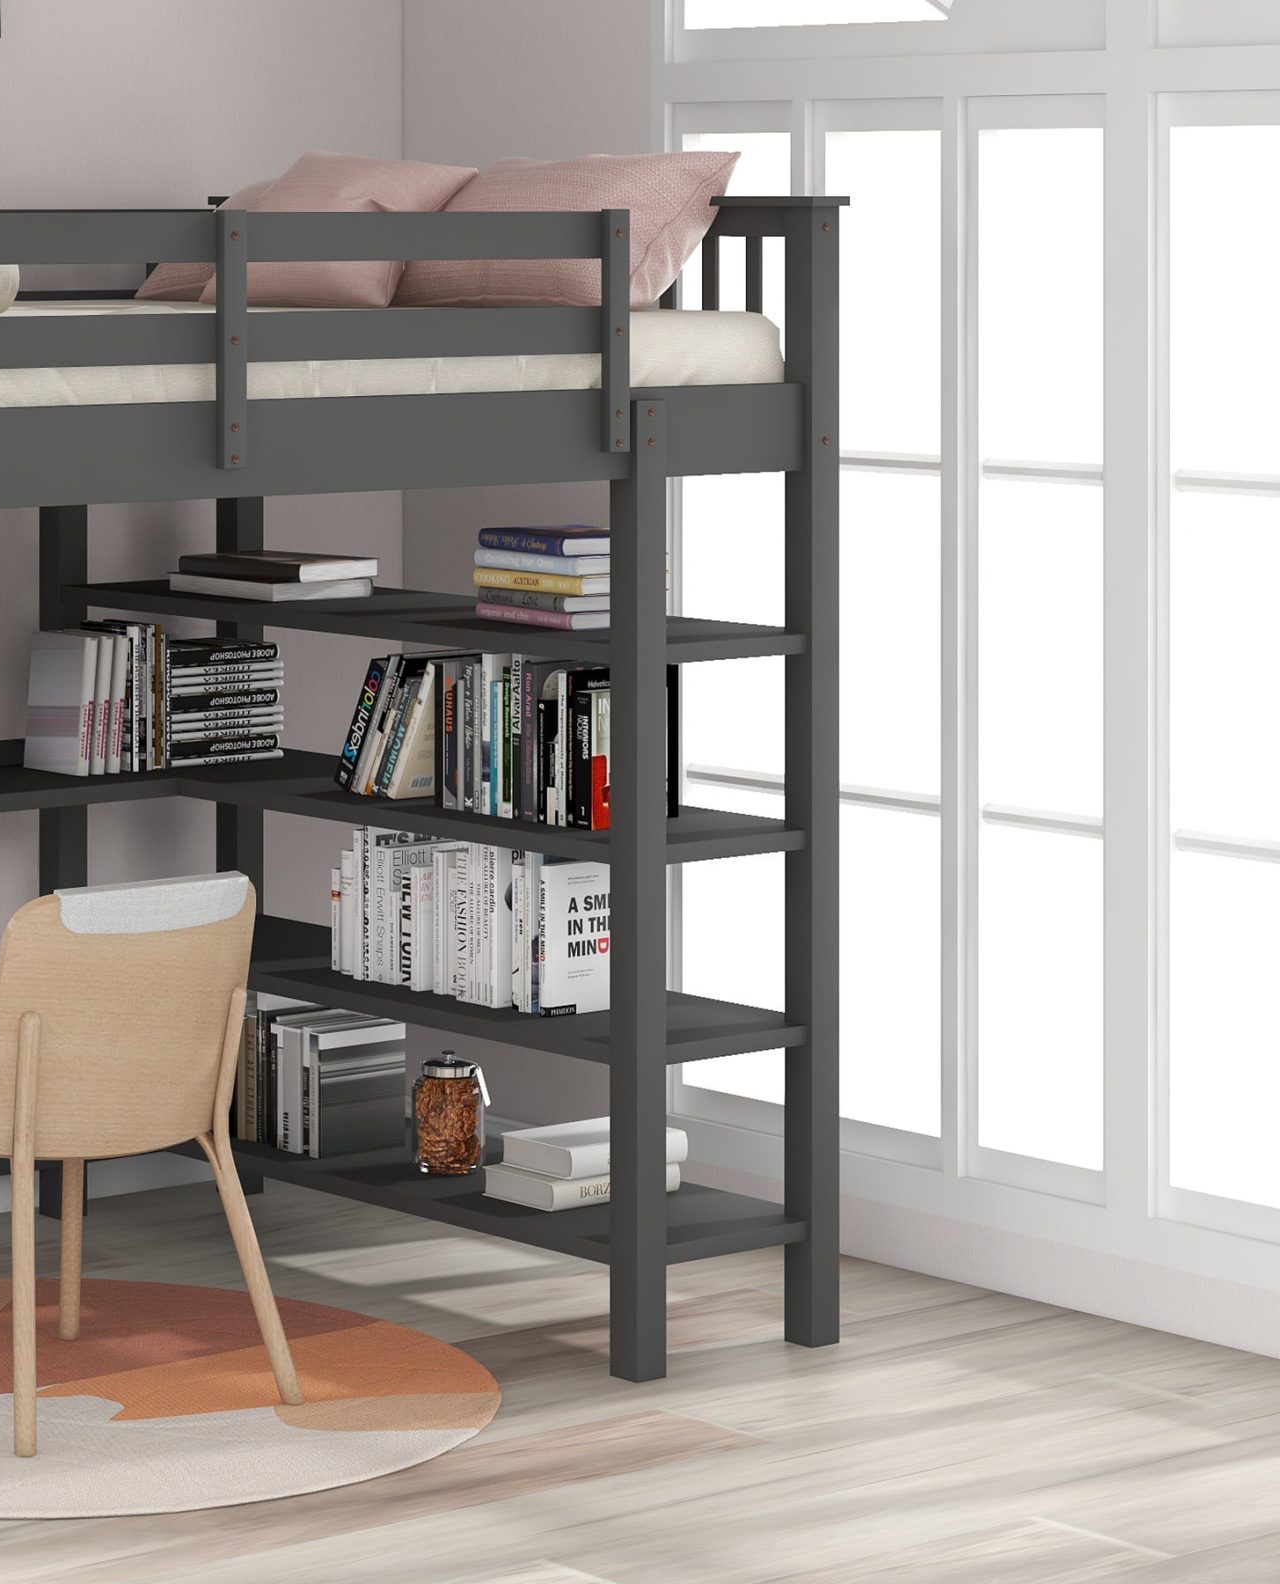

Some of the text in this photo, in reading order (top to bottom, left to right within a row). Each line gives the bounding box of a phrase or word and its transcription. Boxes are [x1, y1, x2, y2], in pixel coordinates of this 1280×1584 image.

[209, 648, 275, 661] ADOBE PHOTOSHOP
[209, 693, 275, 706] ADOBE PHOTOSHOP
[209, 738, 275, 751] ADOBE PHOTOSHOP
[392, 848, 425, 867] Elliott
[376, 850, 386, 967] Elliott Erwitt Snaps
[568, 897, 578, 914] A
[457, 854, 467, 998] THE FASHION BOOK
[540, 913, 545, 922] IN
[568, 918, 583, 936] IN
[568, 937, 609, 958] MIND
[550, 1004, 576, 1016] PHAIDON
